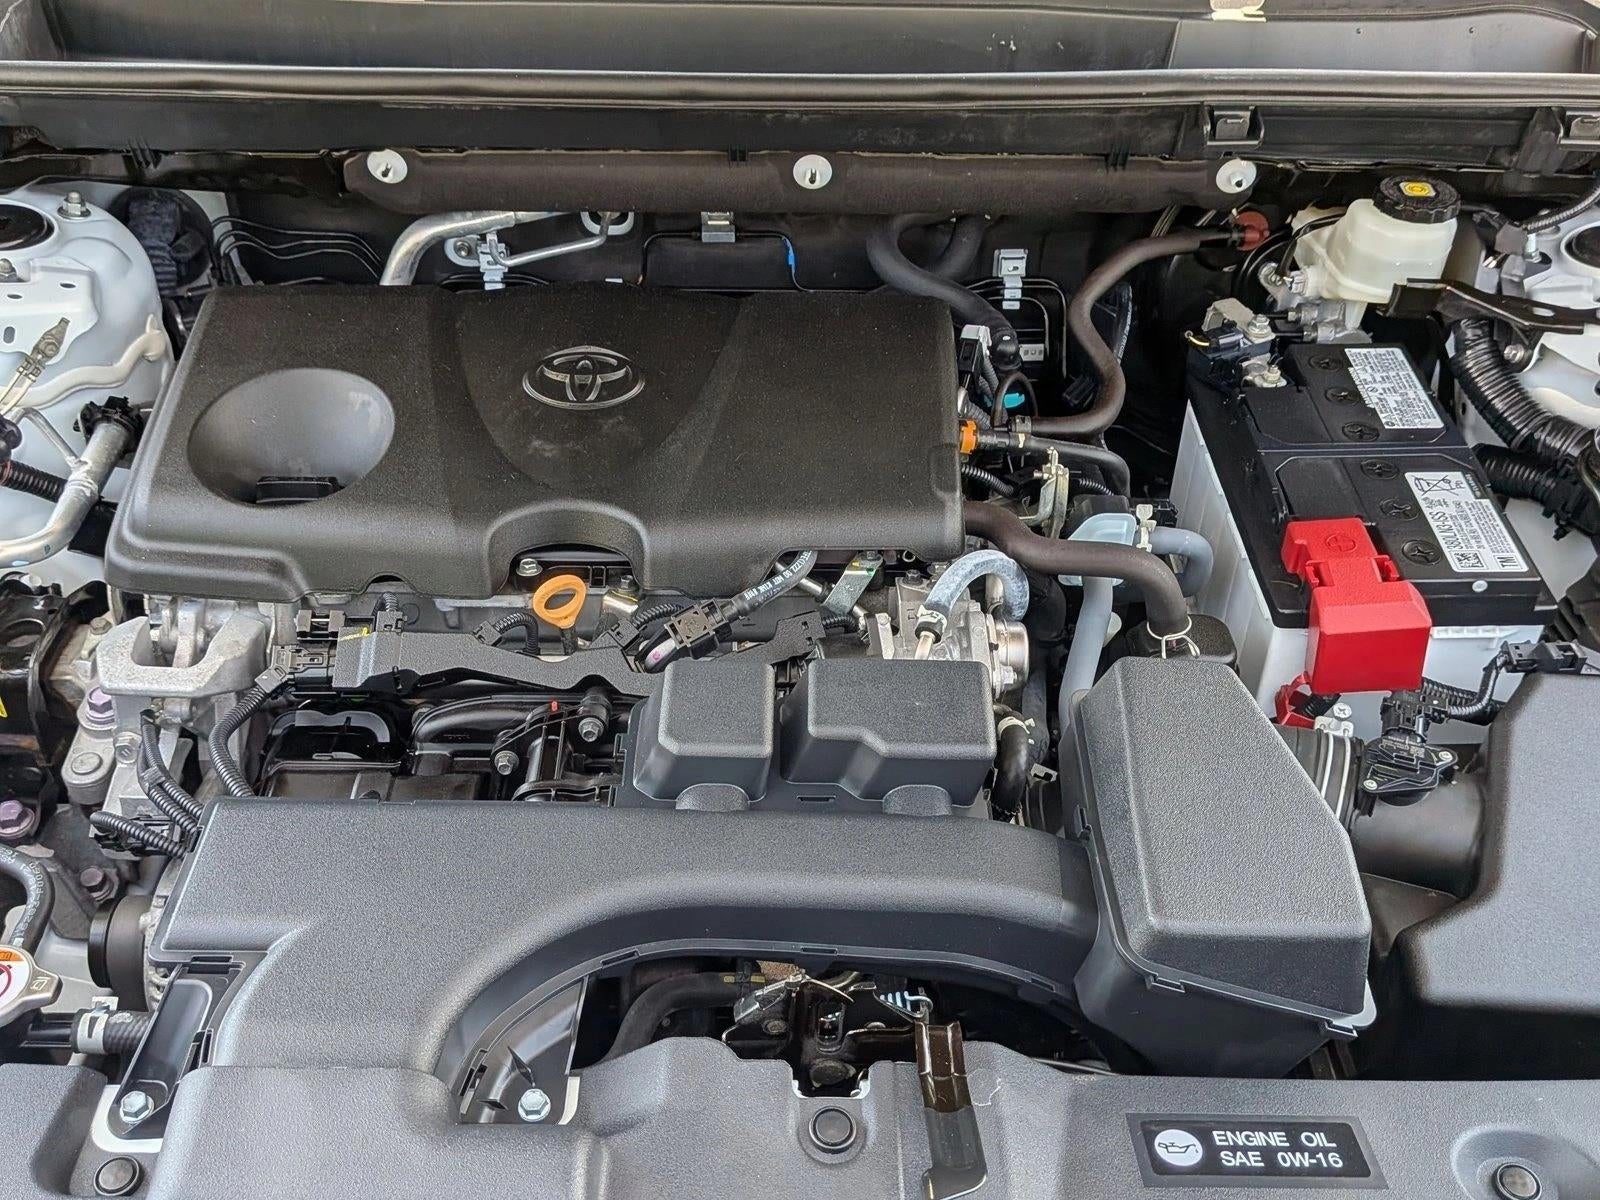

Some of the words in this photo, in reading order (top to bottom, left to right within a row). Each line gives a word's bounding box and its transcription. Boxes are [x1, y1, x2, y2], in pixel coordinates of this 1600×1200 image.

[1497, 556, 1519, 568] TM
[1212, 1130, 1290, 1146] ENGINE
[1301, 1131, 1337, 1147] OIL
[1221, 1151, 1265, 1167] SAE
[1278, 1152, 1343, 1168] 0W-16
